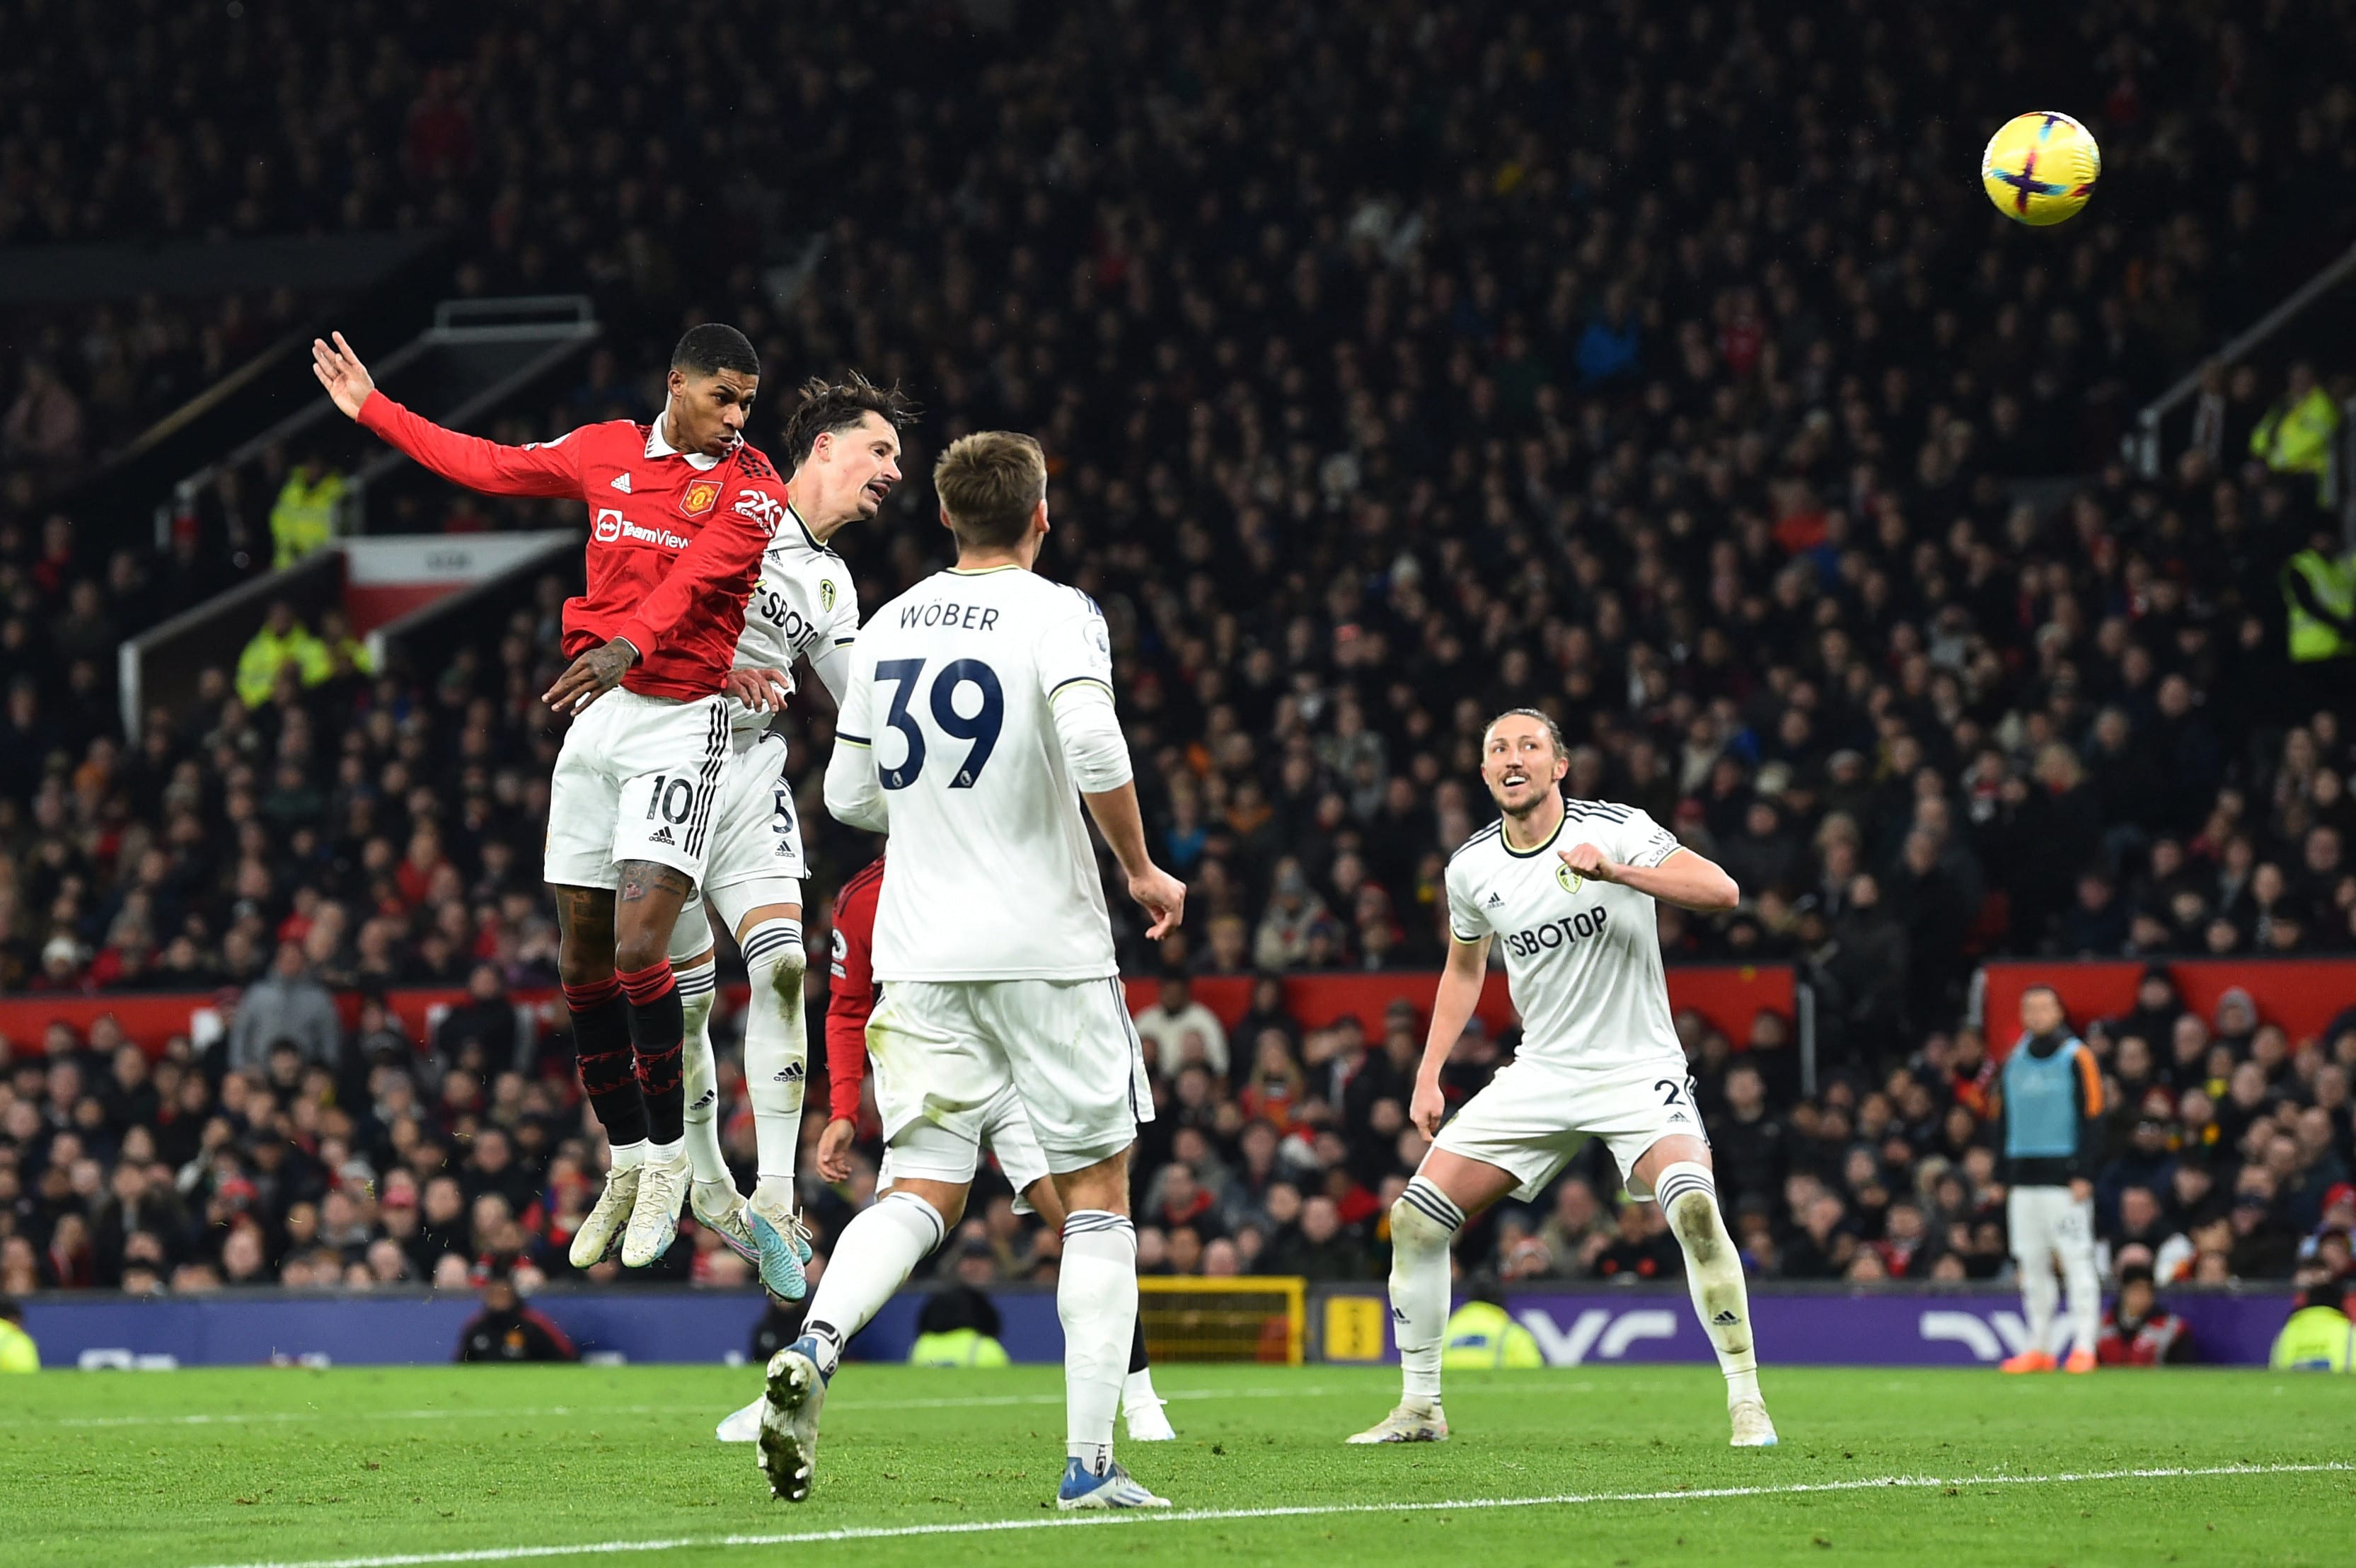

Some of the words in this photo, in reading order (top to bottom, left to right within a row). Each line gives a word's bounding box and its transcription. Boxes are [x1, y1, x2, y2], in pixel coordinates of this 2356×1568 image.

[900, 597, 999, 631] WÖBER
[874, 658, 1004, 790] 39
[647, 776, 693, 824] 10
[773, 790, 794, 834] 5
[649, 835, 676, 846] adidas
[1509, 905, 1607, 957] SBOTOP
[1654, 1079, 1687, 1107] 2
